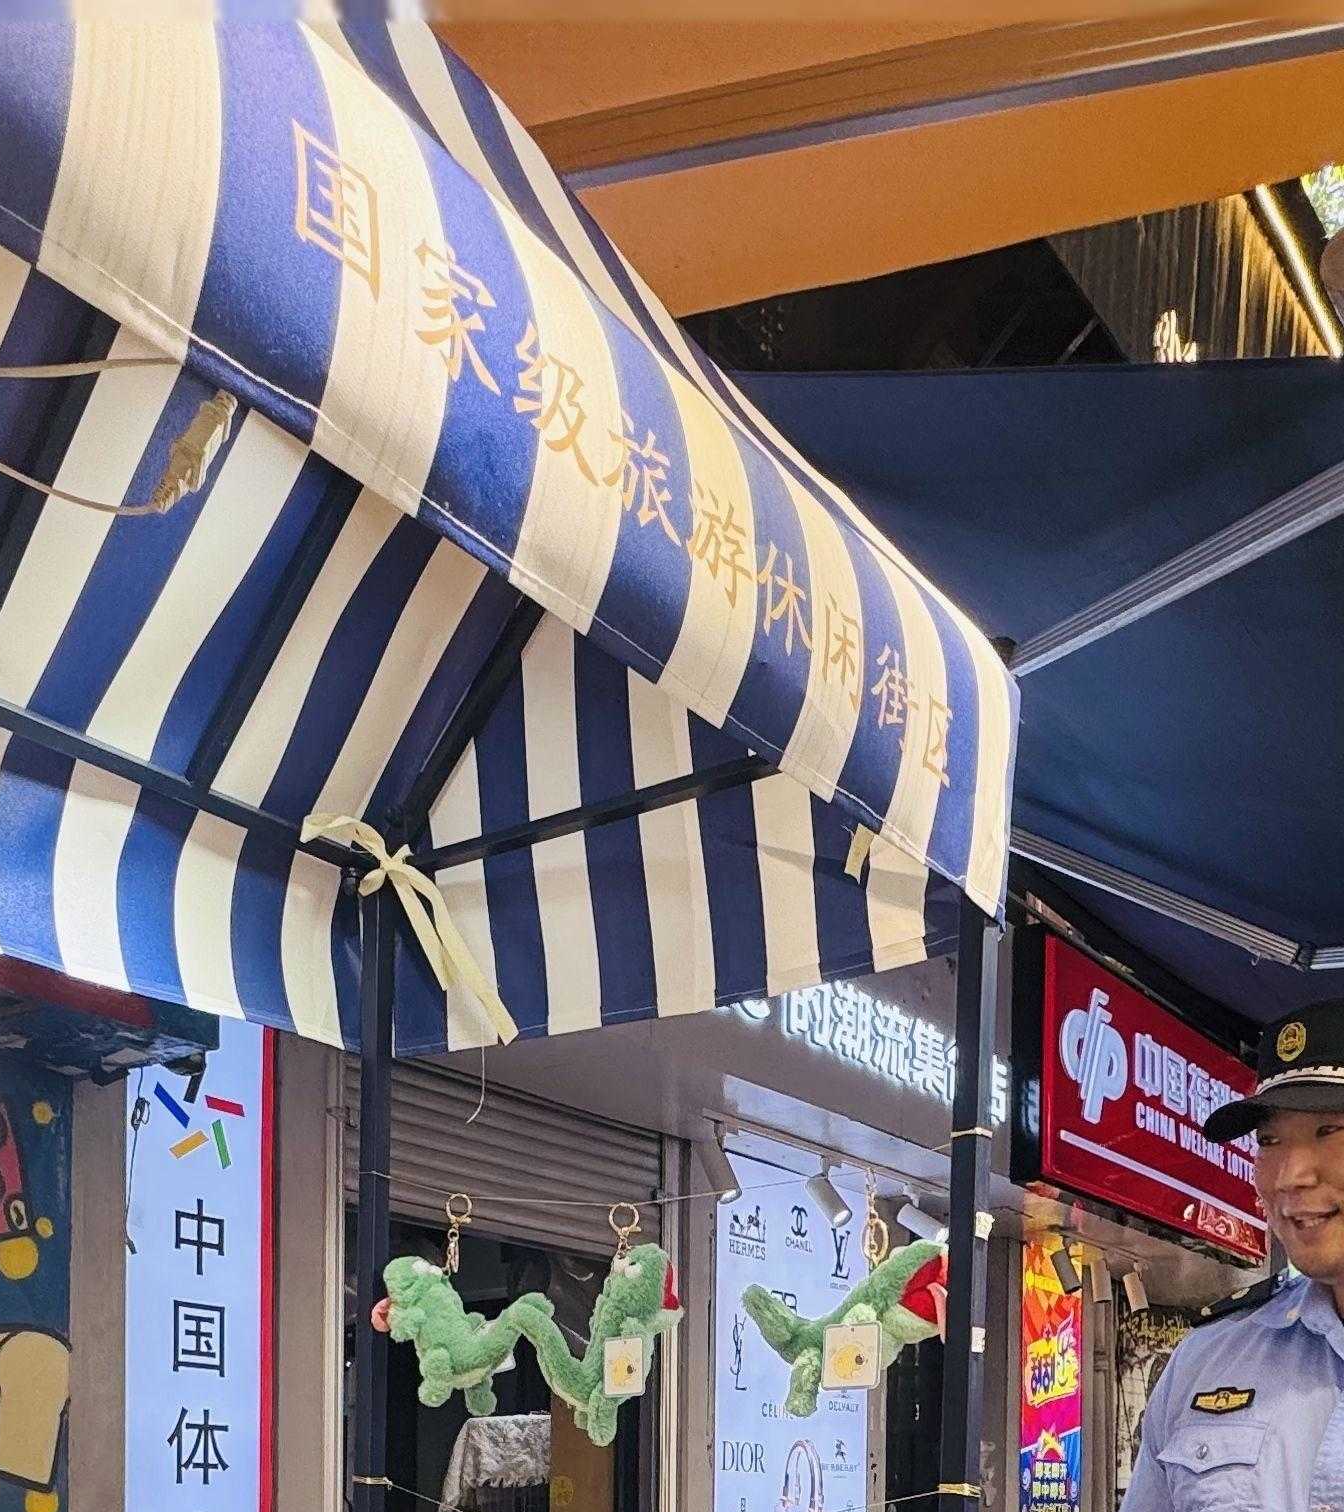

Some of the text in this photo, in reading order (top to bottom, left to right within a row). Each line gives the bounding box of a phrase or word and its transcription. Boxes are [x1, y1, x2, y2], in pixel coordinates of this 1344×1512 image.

[292, 117, 952, 786] 国家级旅游休闲街区
[739, 980, 1007, 1126] 的潮流集
[1134, 1032, 1260, 1156] 中国福
[1135, 1101, 1176, 1144] CHINA
[785, 1236, 813, 1254] CHANEL
[721, 1440, 766, 1474] DIOR
